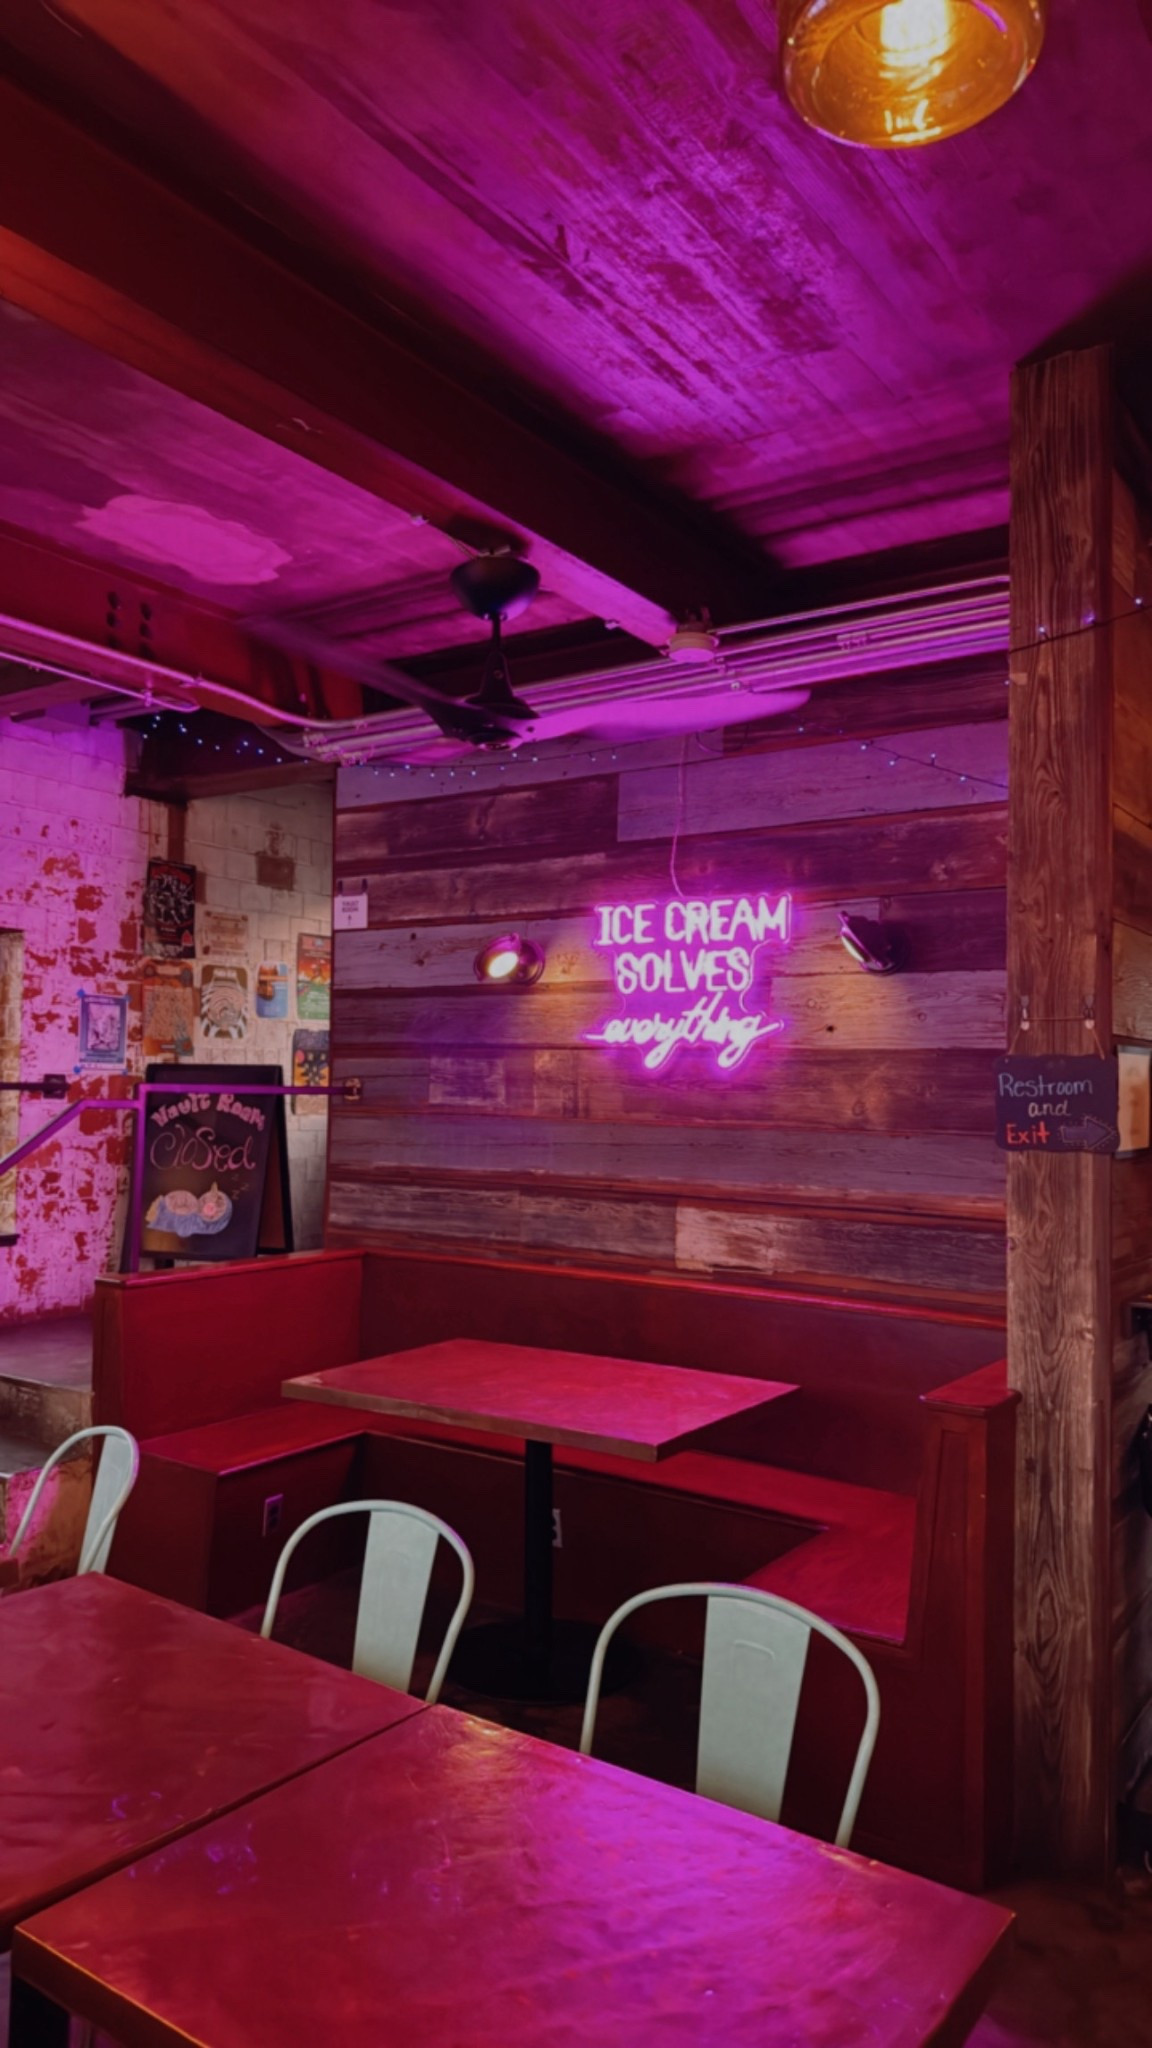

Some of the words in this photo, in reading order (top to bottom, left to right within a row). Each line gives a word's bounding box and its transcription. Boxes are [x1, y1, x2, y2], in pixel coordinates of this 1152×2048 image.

[594, 904, 656, 946] ICE
[664, 897, 788, 945] CREAM
[616, 947, 751, 994] SOLVES
[584, 992, 782, 1069] everything
[997, 1072, 1094, 1097] Restroom
[1028, 1100, 1071, 1118] and
[1006, 1121, 1050, 1144] Exit
